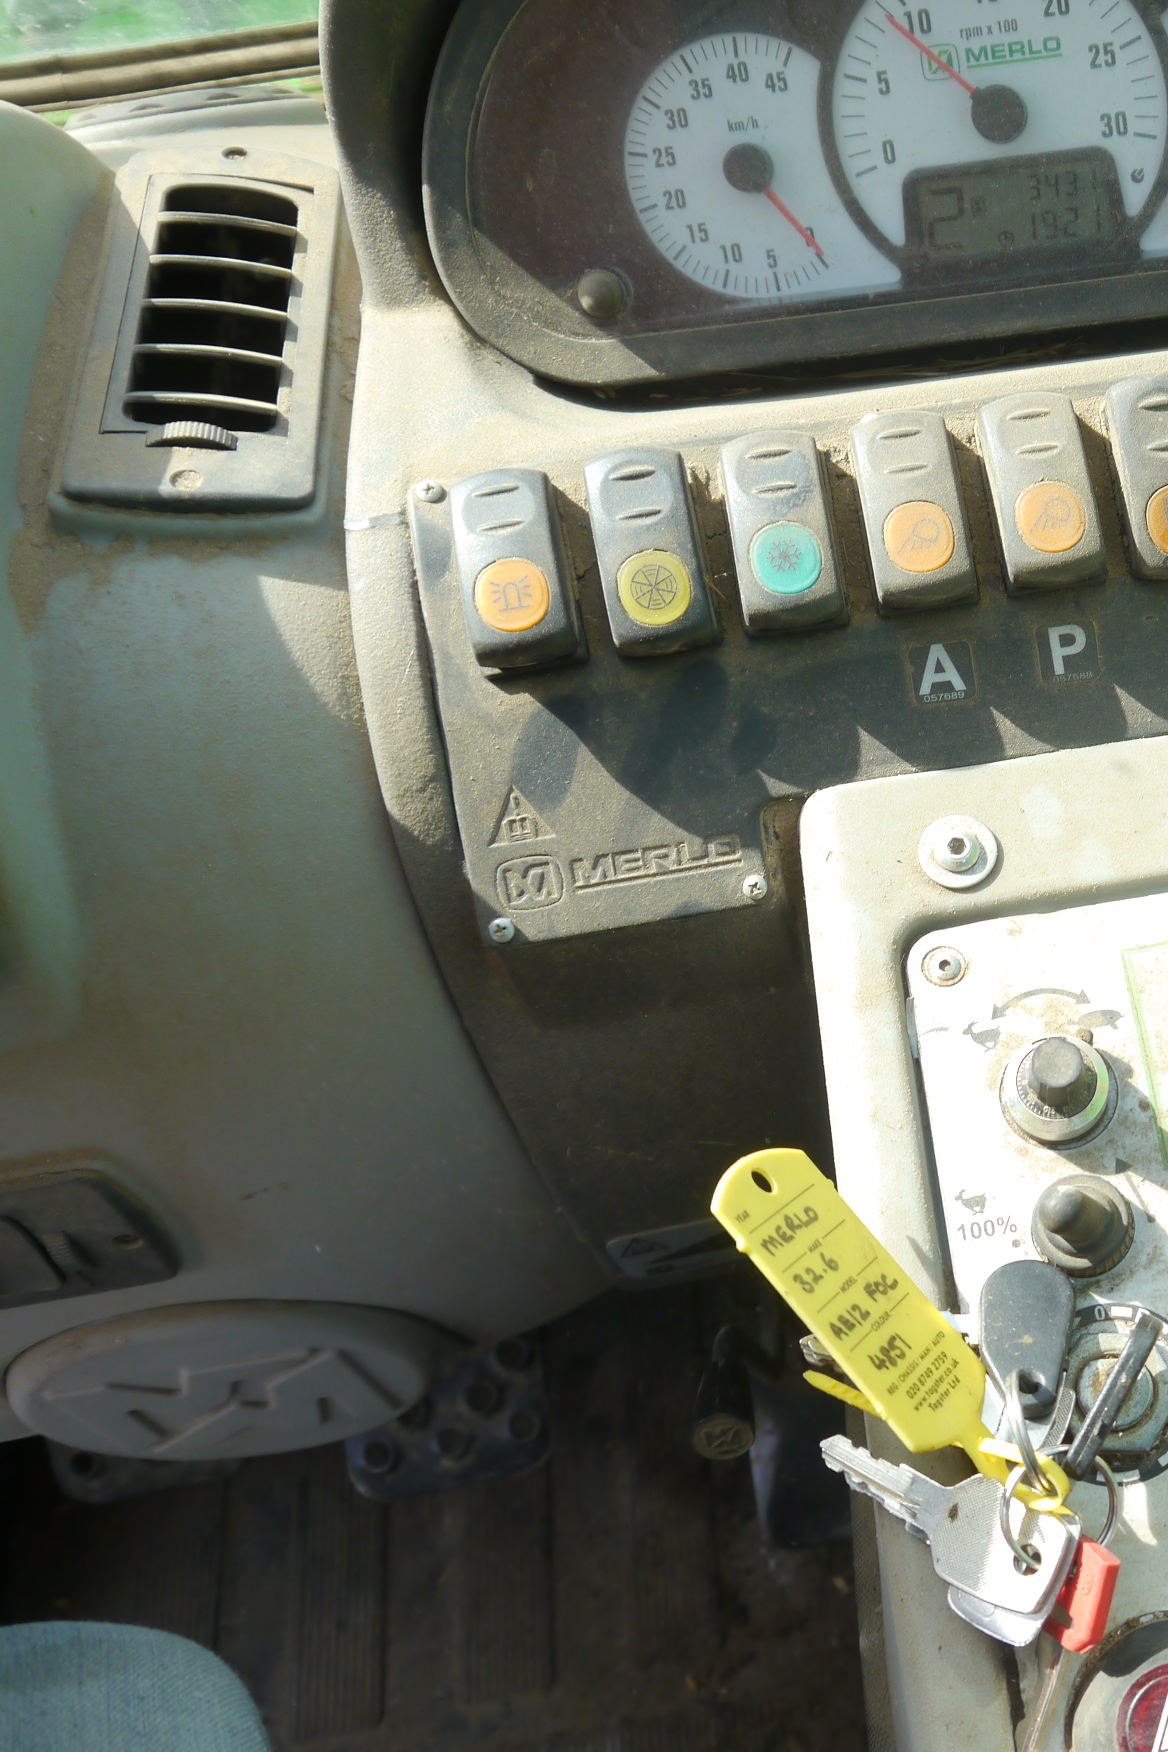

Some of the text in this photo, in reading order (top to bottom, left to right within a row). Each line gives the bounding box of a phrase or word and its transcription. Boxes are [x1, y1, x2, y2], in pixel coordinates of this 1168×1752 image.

[1044, 0, 1070, 17] 20
[904, 8, 932, 35] 10
[960, 22, 982, 41] rpm
[996, 18, 1018, 34] 100
[965, 36, 1062, 64] MERLO
[1088, 42, 1116, 70] 25
[725, 61, 750, 84] 40
[764, 71, 788, 94] 45
[876, 70, 890, 96] 5
[688, 78, 713, 100] 35
[664, 108, 689, 130] 30
[726, 116, 759, 134] km/h
[1100, 111, 1128, 138] 30
[652, 146, 676, 168] 25
[882, 140, 896, 164] 0
[662, 188, 686, 210] 20
[928, 185, 964, 250] 2
[686, 222, 709, 244] 15
[720, 242, 742, 264] 10
[766, 248, 778, 270] 5
[1048, 624, 1086, 676] P
[919, 643, 966, 696] A
[923, 690, 965, 703] 057689
[569, 833, 742, 888] MERLO
[734, 1209, 751, 1224] YEAR
[956, 1214, 1018, 1242] 100%
[760, 1206, 819, 1257] MERLO
[808, 1238, 823, 1253] MAKE
[792, 1252, 840, 1294] 32.6
[840, 1276, 858, 1294] MODEL
[864, 1273, 899, 1302] FOC
[870, 1310, 892, 1332] COLOUR
[867, 1332, 912, 1370] 4851
[898, 1359, 919, 1383] CHASSIS
[932, 1330, 946, 1347] AUTO
[906, 1382, 921, 1400] 020
[931, 1350, 948, 1371] 2759
[947, 1374, 961, 1390] Ltd
